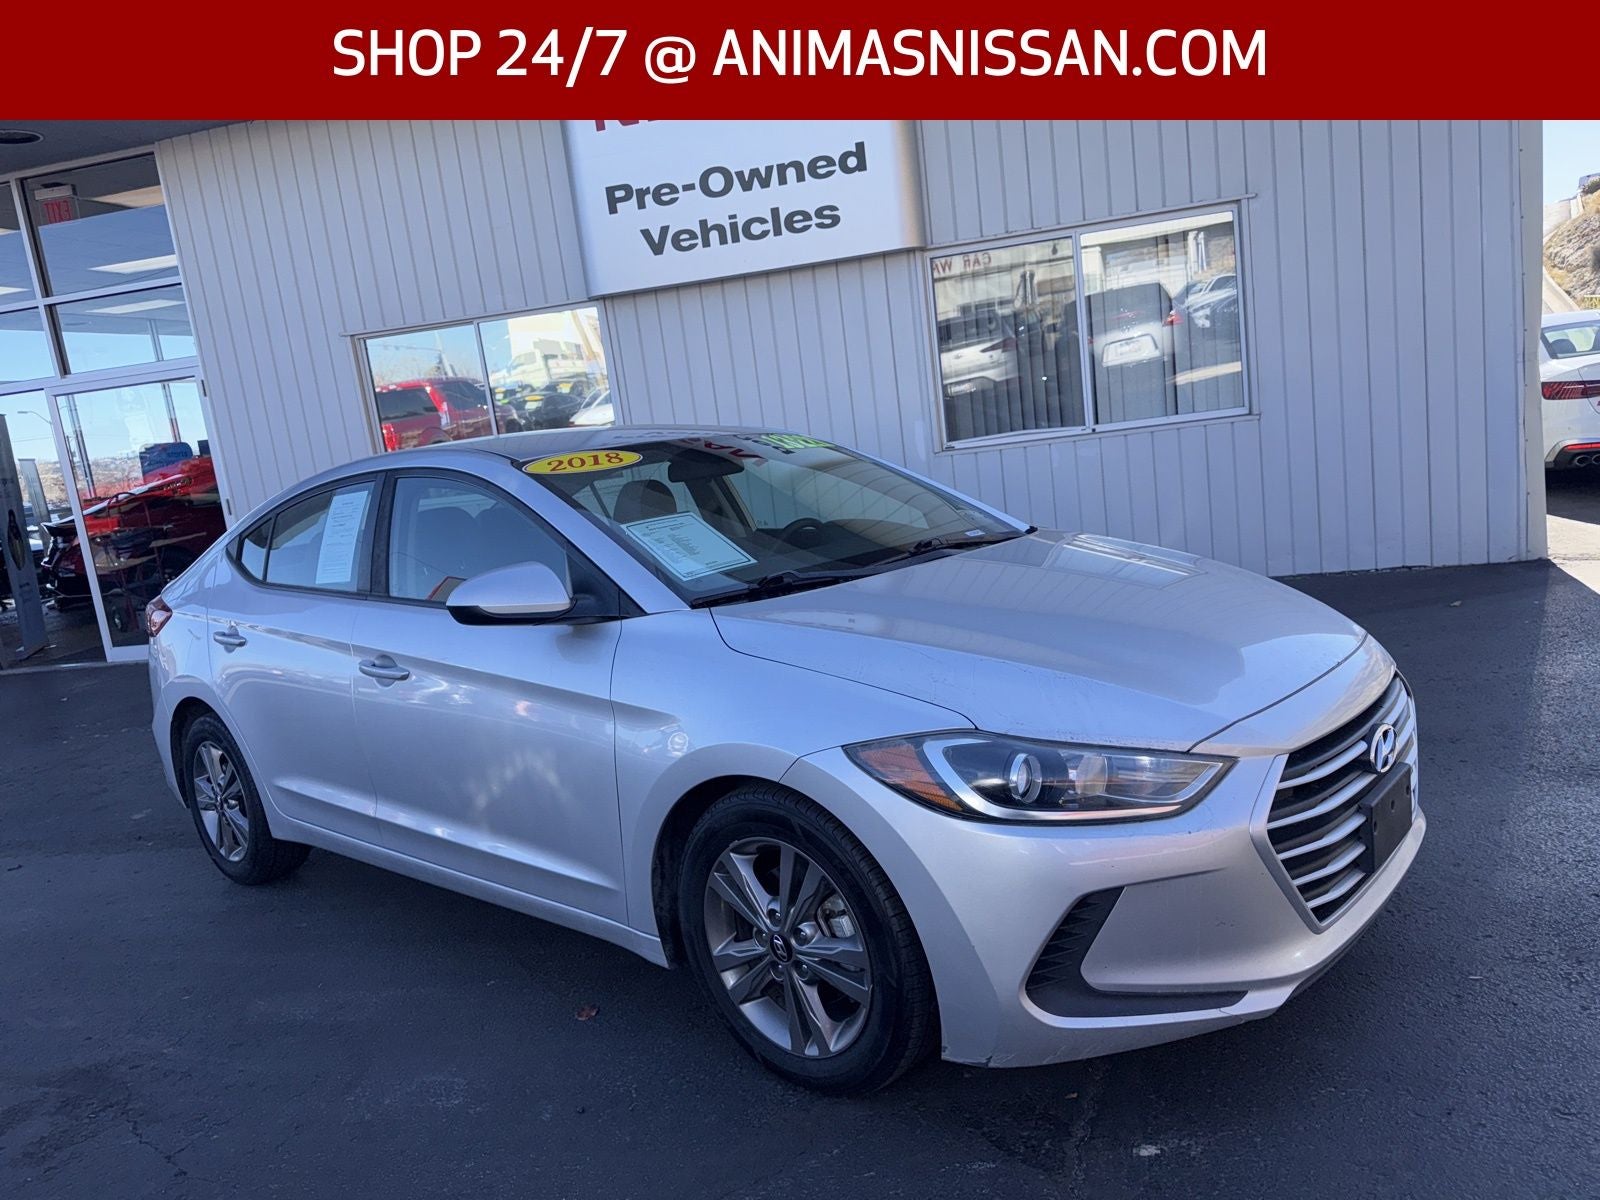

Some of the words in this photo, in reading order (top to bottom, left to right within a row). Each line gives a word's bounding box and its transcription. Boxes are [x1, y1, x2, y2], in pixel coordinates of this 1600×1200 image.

[605, 141, 867, 215] Pre-Owned
[639, 204, 841, 256] Vehicles
[547, 452, 624, 472] 2018
